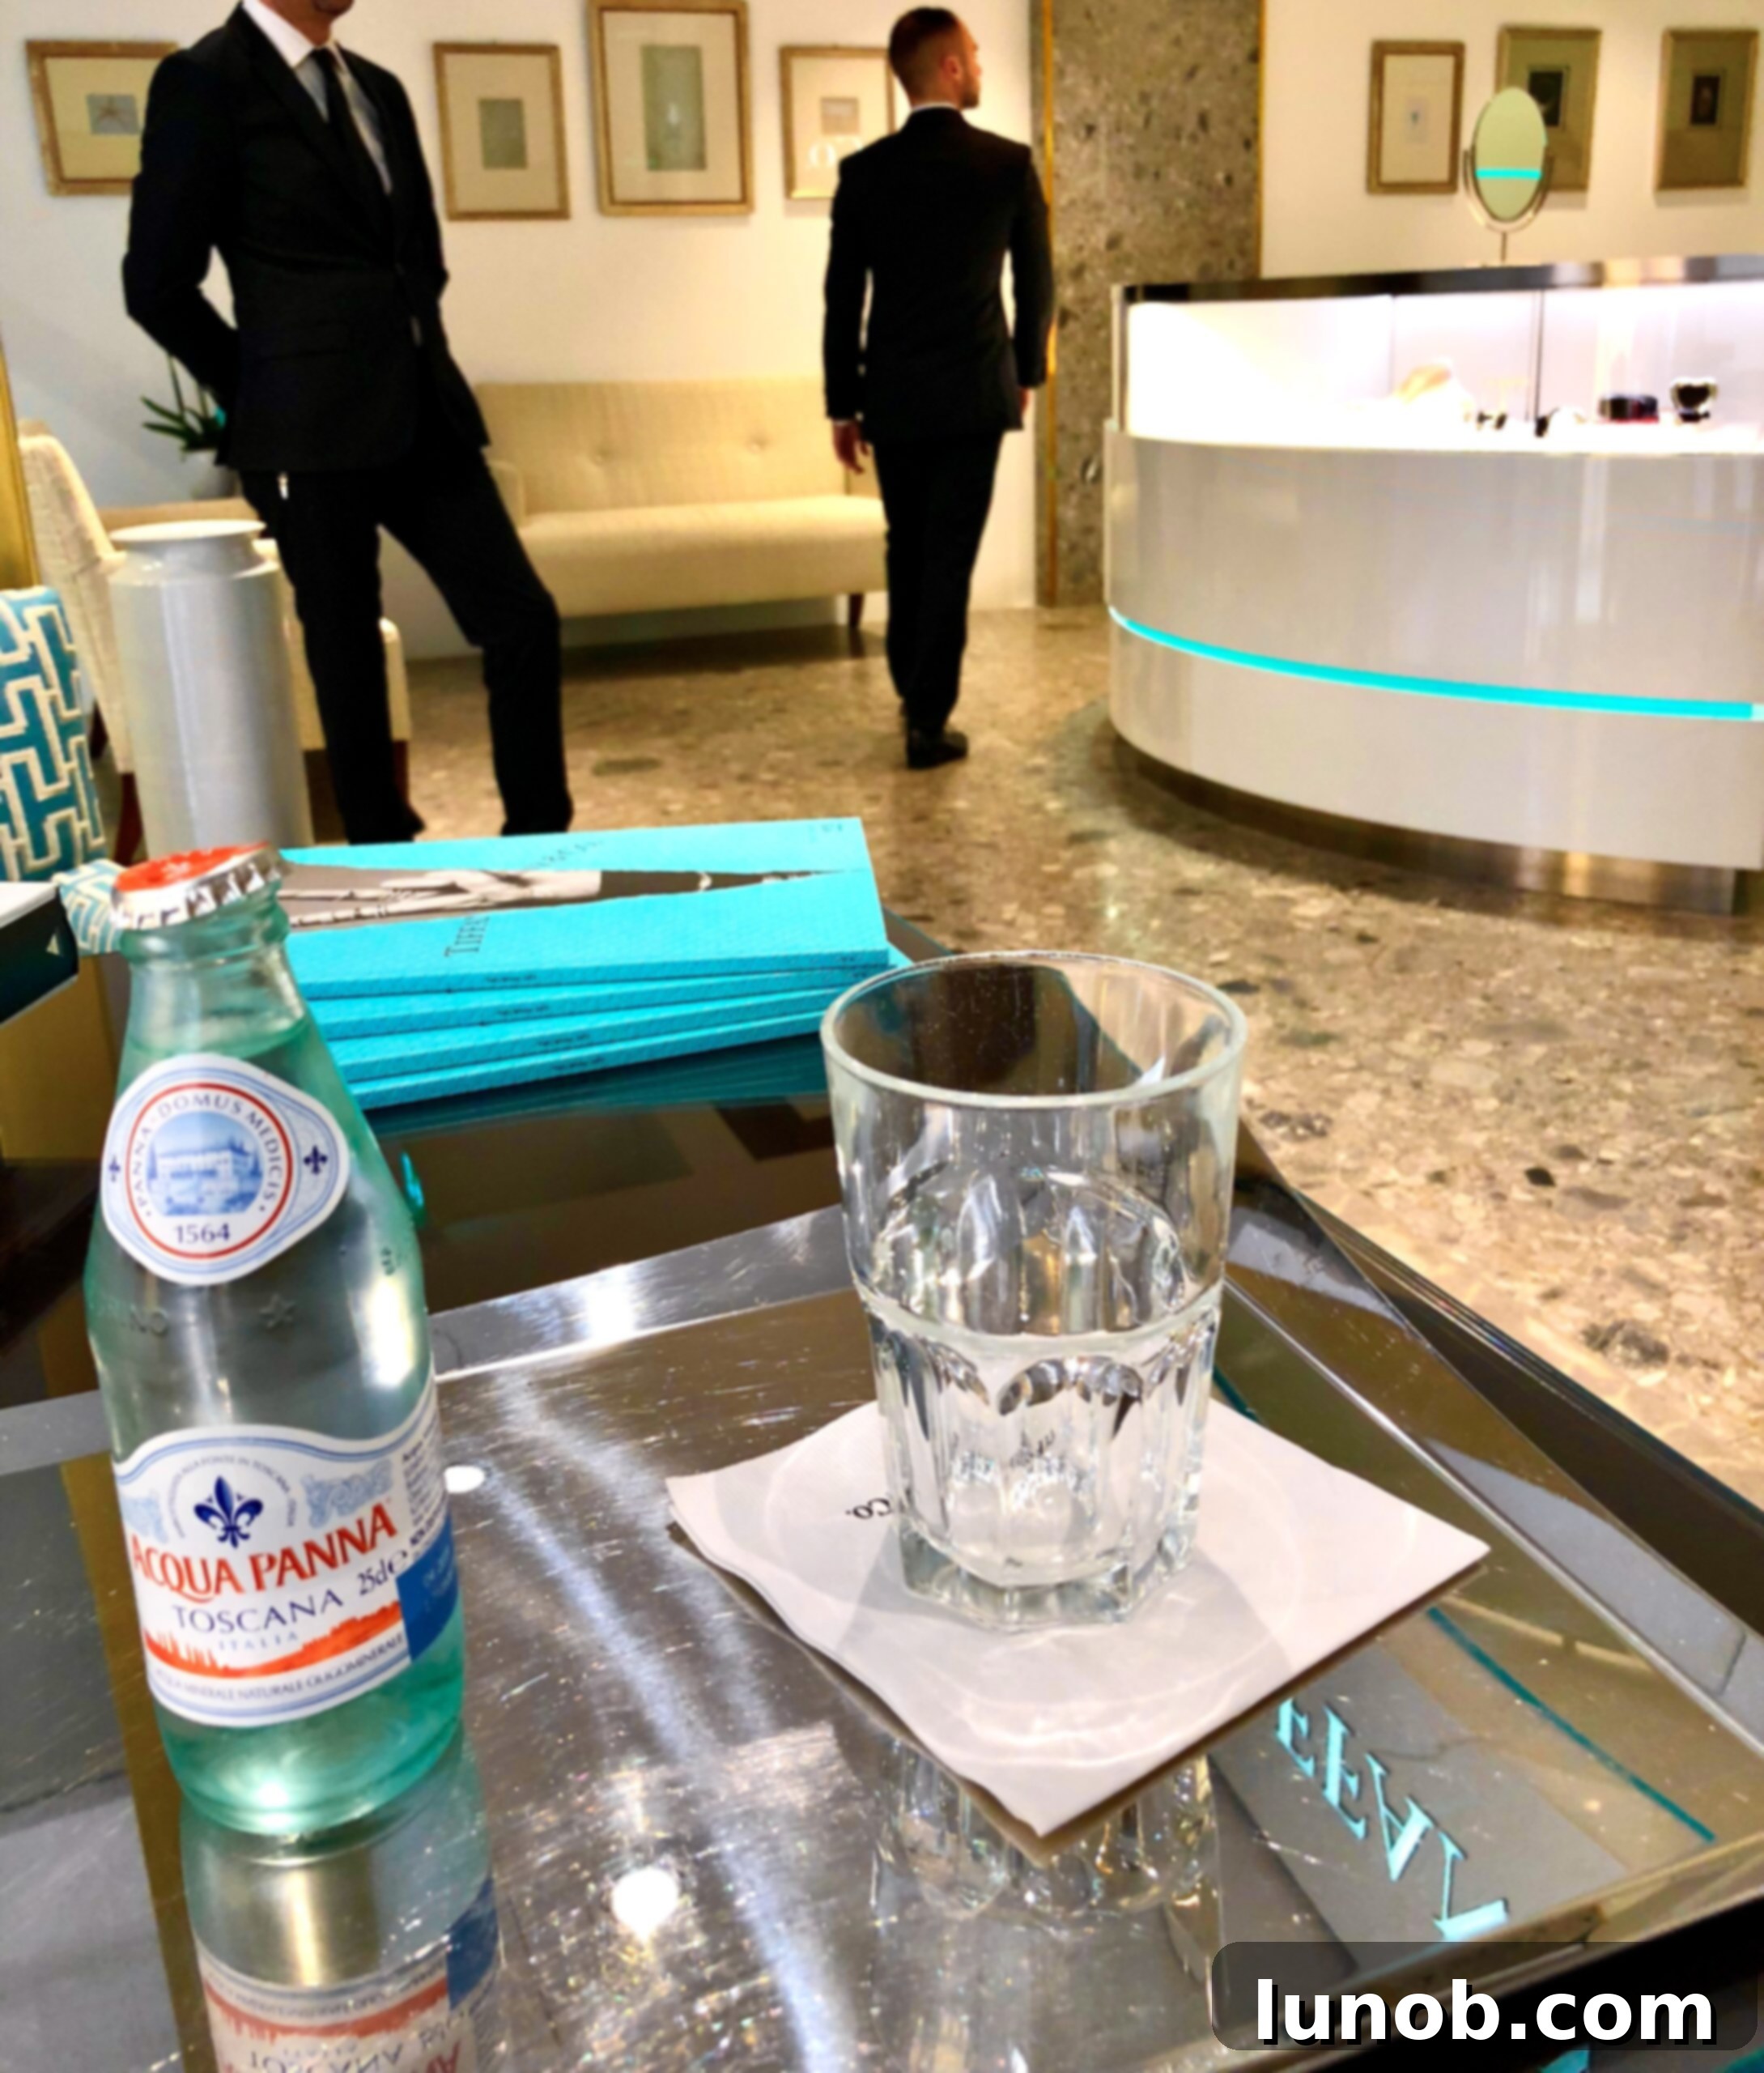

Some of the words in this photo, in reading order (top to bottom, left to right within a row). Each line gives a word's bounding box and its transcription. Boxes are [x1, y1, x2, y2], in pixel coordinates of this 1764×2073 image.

[132, 1126, 151, 1208] PANNA
[158, 1092, 242, 1118] DOMUS
[244, 1112, 283, 1202] MEDICIS
[173, 1222, 231, 1244] 1564
[131, 1533, 245, 1603] ACQUA
[249, 1501, 397, 1593] PANNA
[172, 1587, 343, 1634] TOSCANA
[217, 1631, 299, 1652] ITALIA
[237, 1679, 303, 1700] NATURALE
[306, 1633, 403, 1688] OLIGOMINERALE
